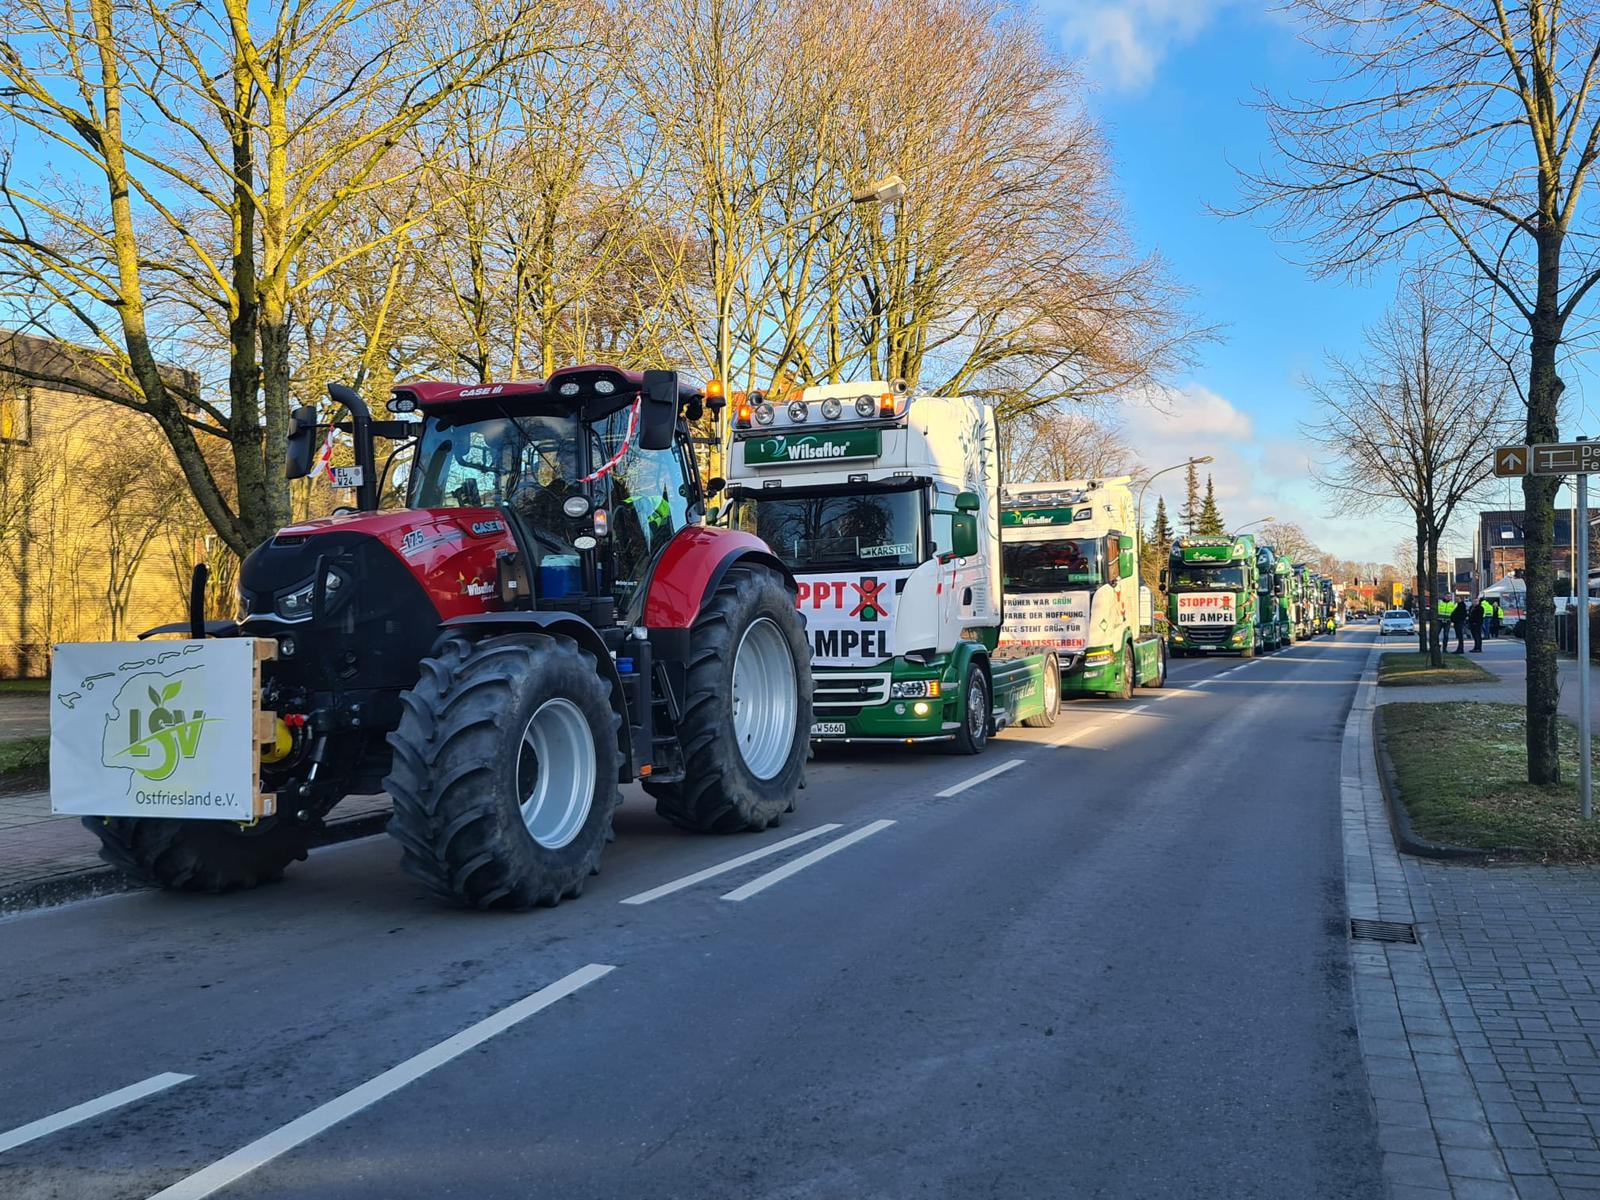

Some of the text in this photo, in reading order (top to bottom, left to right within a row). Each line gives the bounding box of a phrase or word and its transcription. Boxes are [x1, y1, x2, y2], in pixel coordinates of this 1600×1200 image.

[459, 387, 492, 397] CASE
[788, 441, 847, 460] Wilsaflor
[337, 468, 348, 477] EL
[871, 544, 912, 556] KARSTEN
[1033, 598, 1050, 606] WAR
[1052, 597, 1072, 605] GRÜN
[1179, 597, 1219, 608] STOPPT
[1180, 612, 1235, 622] DIE AMPEL
[1066, 624, 1081, 632] FÜR
[805, 629, 893, 658] MPEL
[129, 706, 207, 781] LSV
[135, 790, 239, 807] Ostfriesland e.V.
